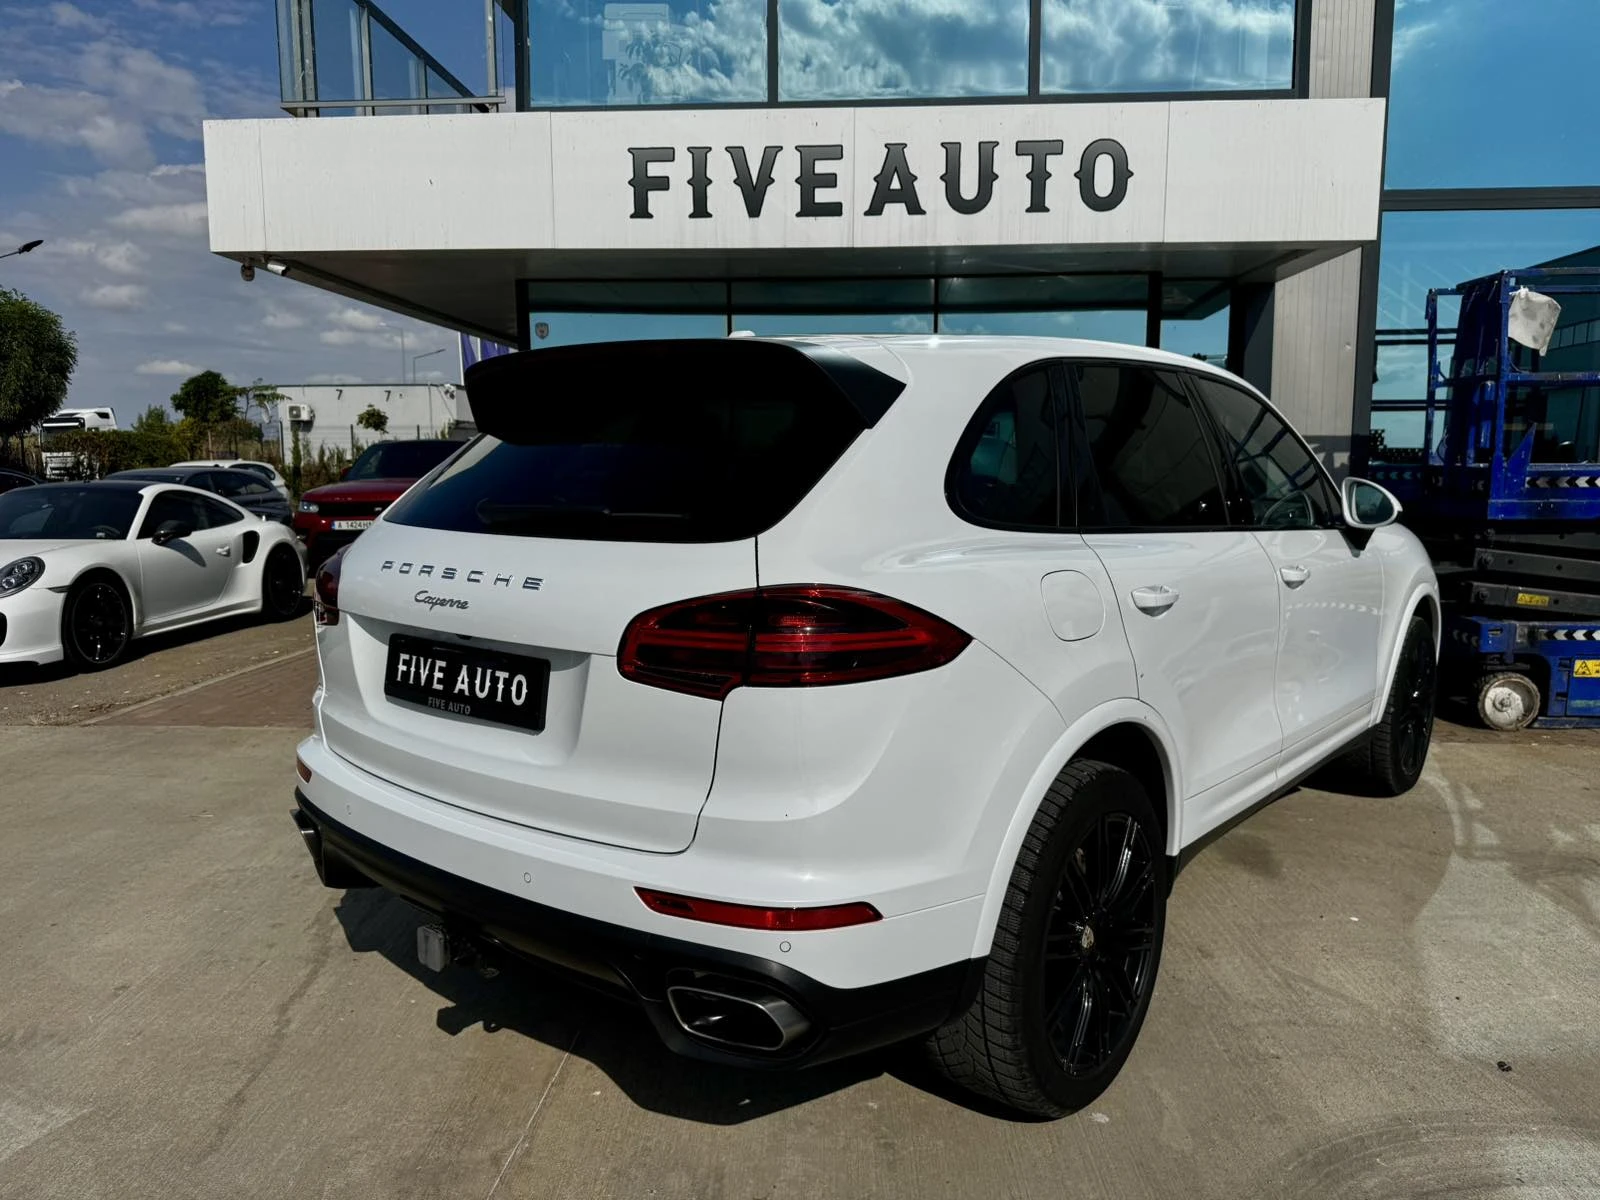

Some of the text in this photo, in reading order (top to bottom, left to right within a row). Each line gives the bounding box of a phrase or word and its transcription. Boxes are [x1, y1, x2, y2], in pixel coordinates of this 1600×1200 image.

[381, 560, 545, 591] PORSCHE
[414, 590, 470, 611] Cayenne
[396, 653, 528, 706] FIVE AUTO
[427, 696, 471, 716] FIVE AUTO
